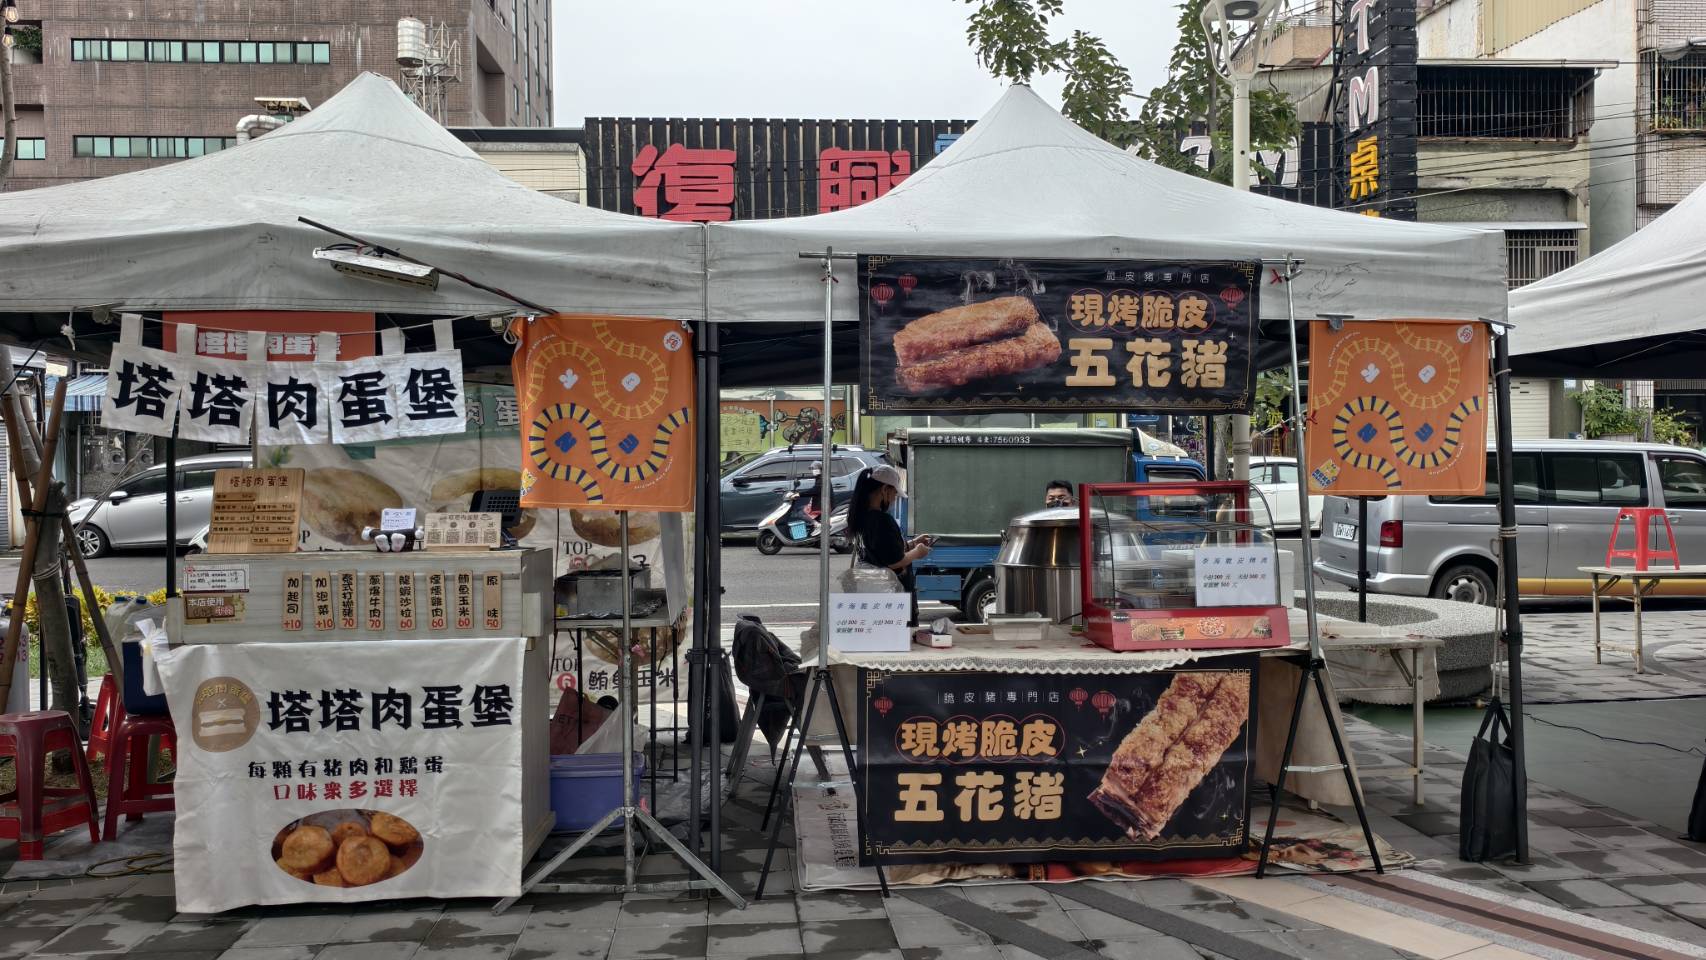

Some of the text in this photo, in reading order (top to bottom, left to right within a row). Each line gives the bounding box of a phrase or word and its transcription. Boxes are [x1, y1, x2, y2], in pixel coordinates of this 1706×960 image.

[631, 143, 912, 222] 復興
[1350, 136, 1380, 217] 桌
[1071, 294, 1208, 329] 現烤脆皮
[1066, 338, 1228, 388] 五花豬
[113, 360, 459, 429] 塔塔肉蛋堡
[563, 541, 593, 555] TOP
[283, 577, 301, 629] 加起司 +10
[315, 577, 333, 628] 加泡菜 +10
[343, 618, 354, 627] 70
[369, 619, 381, 628] 70
[400, 619, 413, 628] 60
[431, 618, 444, 627] 60
[458, 574, 470, 627] 鮪魚玉米 60
[486, 619, 499, 628] 50
[266, 684, 515, 733] 塔塔肉蛋堡
[901, 720, 1058, 757] 現烤脆皮
[894, 771, 1065, 823] 五花豬
